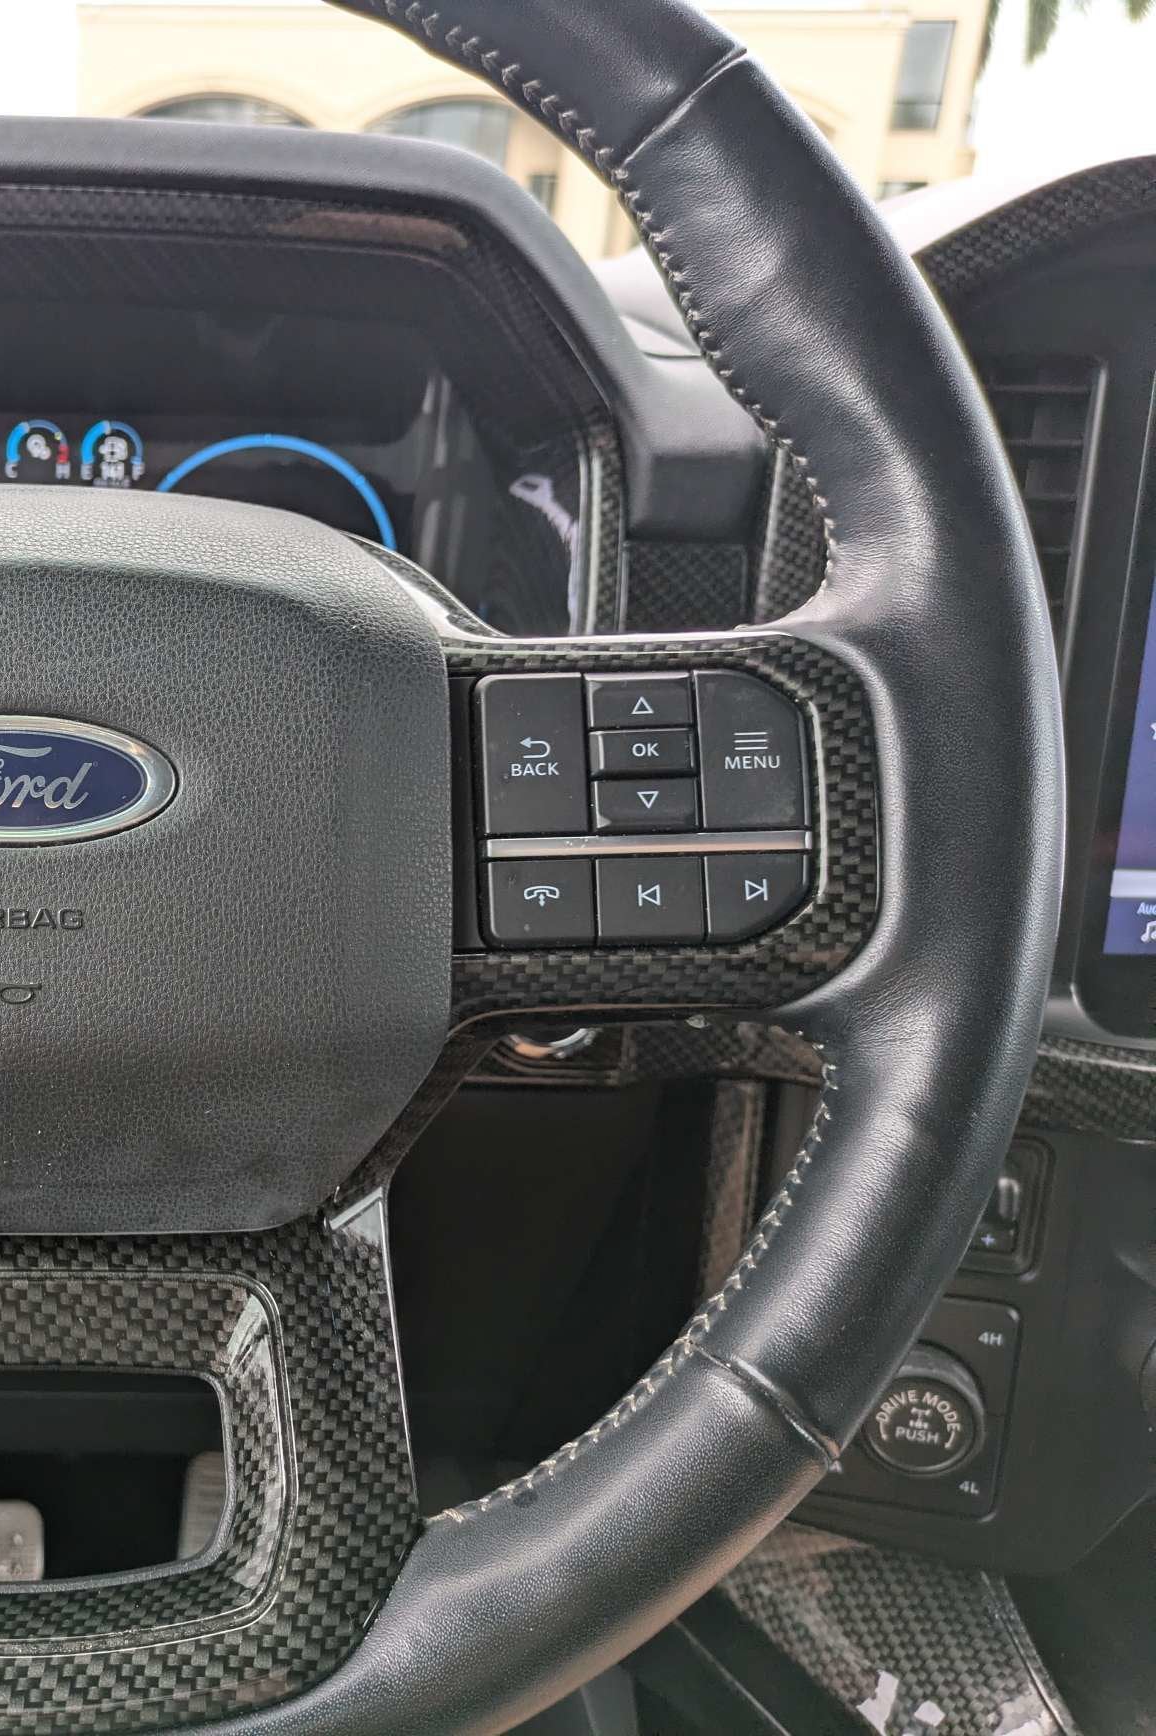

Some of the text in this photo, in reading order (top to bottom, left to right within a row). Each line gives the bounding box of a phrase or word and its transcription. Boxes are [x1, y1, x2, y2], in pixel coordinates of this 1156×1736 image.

[5, 462, 18, 479] C
[55, 462, 71, 480] H
[631, 743, 660, 758] OK
[510, 762, 560, 778] BACK
[724, 754, 781, 770] MENU
[978, 1331, 1004, 1347] 4H
[875, 1389, 962, 1433] DRIVE MODE
[895, 1426, 940, 1444] PUSH
[958, 1480, 980, 1495] 4L
